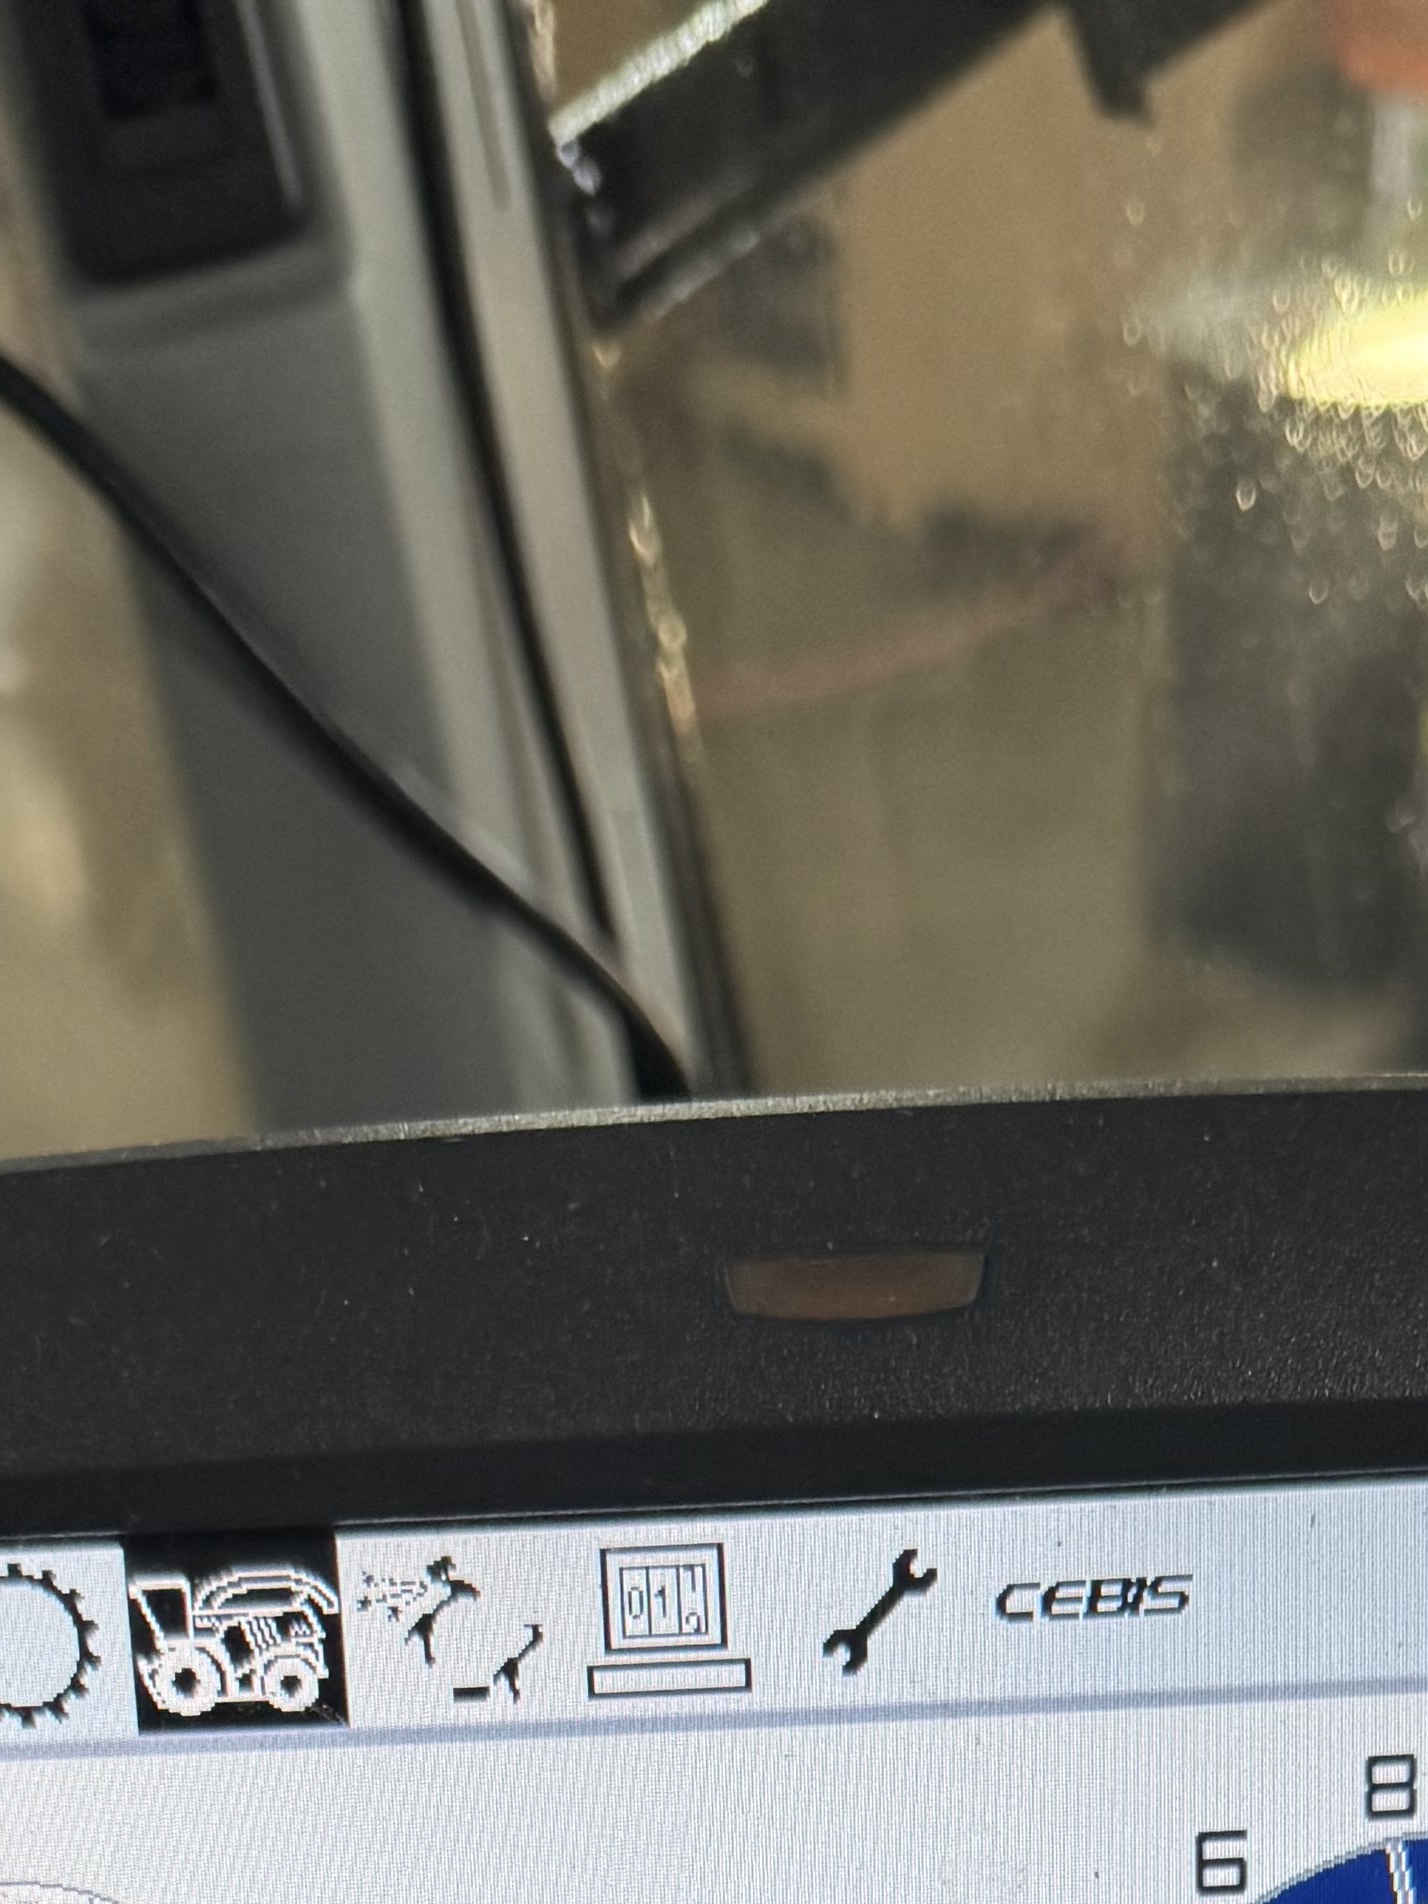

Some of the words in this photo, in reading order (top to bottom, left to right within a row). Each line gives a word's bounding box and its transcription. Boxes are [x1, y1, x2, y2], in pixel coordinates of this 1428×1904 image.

[995, 1574, 1192, 1622] CEBIS
[1365, 1753, 1417, 1820] 8
[1195, 1830, 1247, 1896] 6
